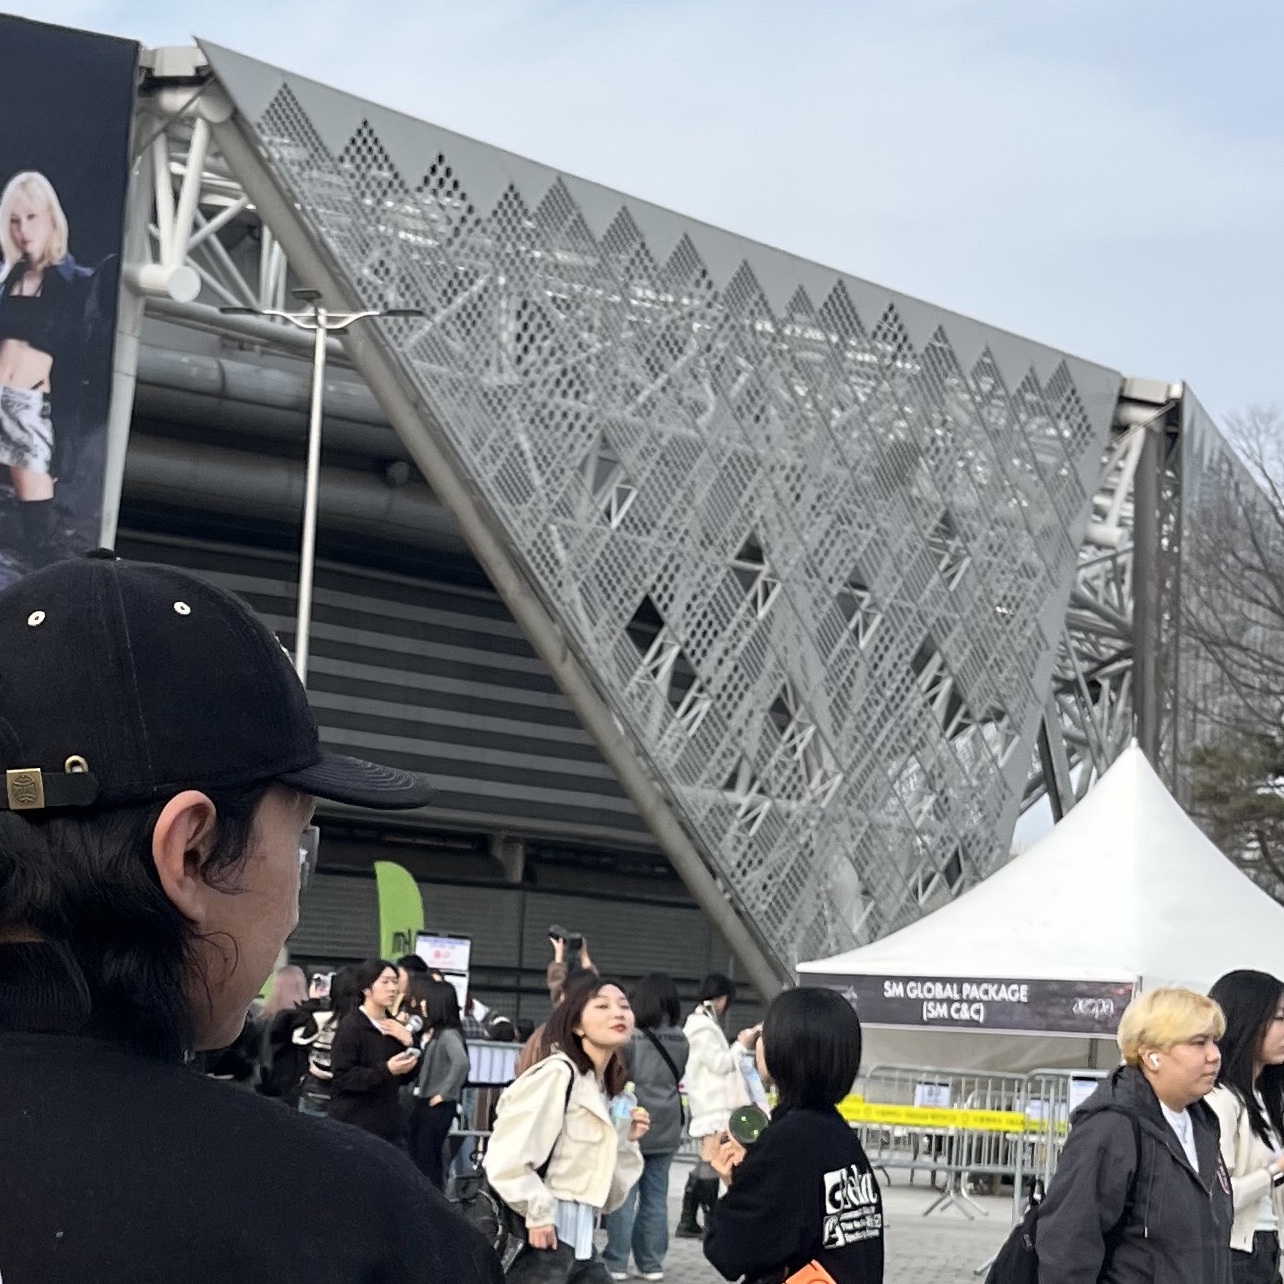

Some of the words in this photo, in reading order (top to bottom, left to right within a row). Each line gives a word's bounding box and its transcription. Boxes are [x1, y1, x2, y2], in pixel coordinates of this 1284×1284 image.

[883, 980, 904, 998] SM
[906, 981, 960, 1000] GLOBAL
[962, 982, 1029, 1003] PACKAGE
[922, 1000, 949, 1021] (SM
[950, 1002, 984, 1023] C&C)
